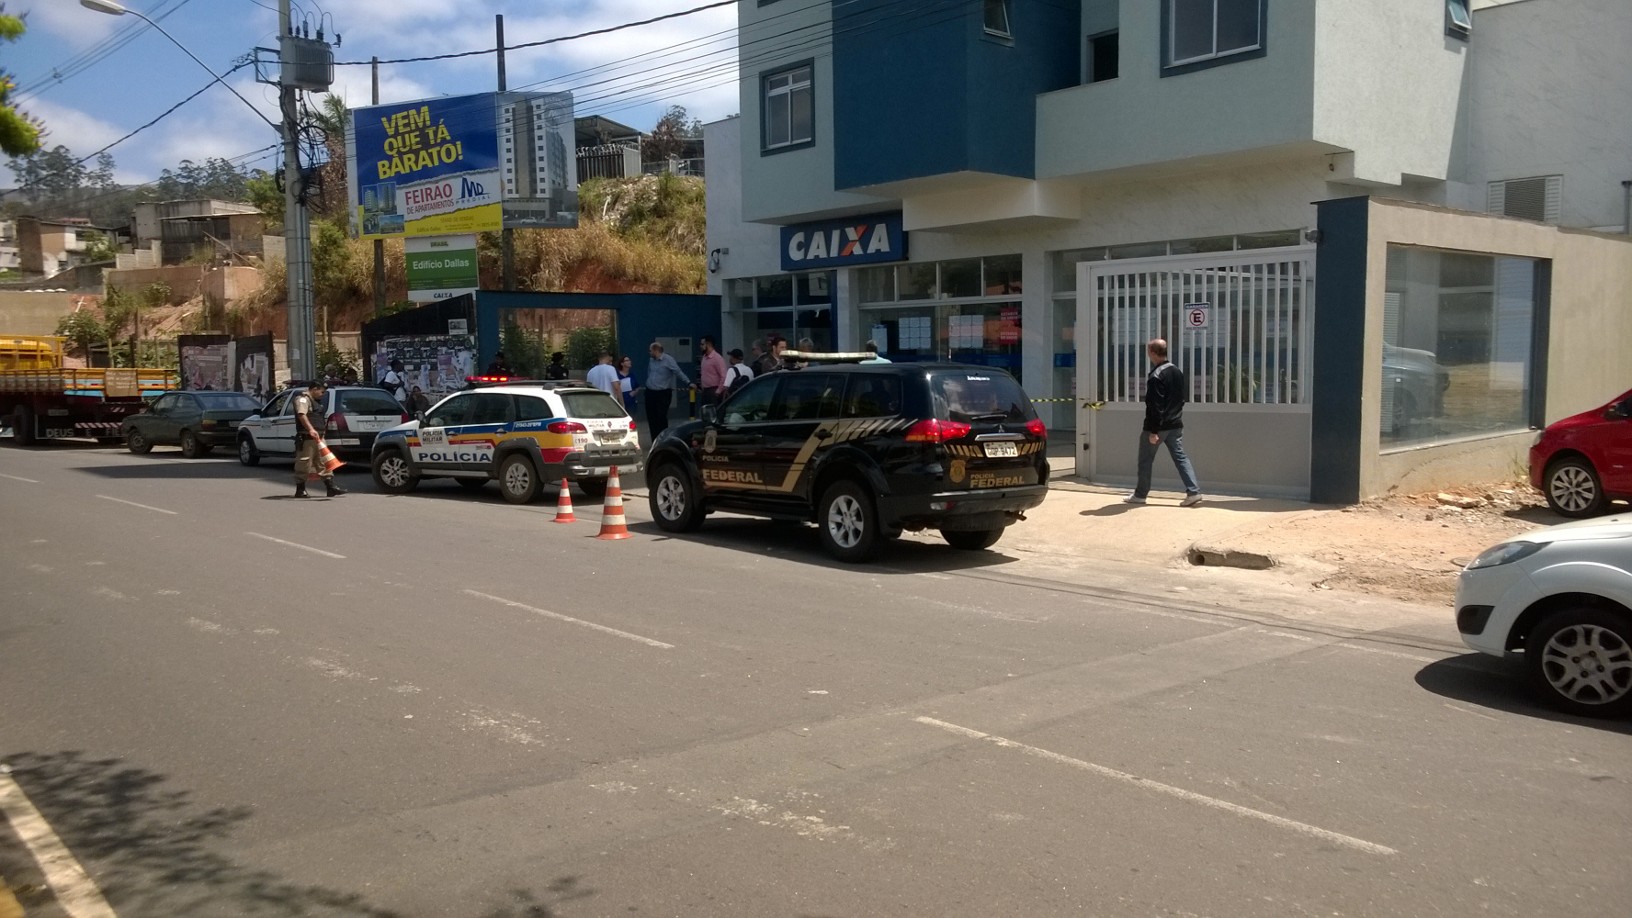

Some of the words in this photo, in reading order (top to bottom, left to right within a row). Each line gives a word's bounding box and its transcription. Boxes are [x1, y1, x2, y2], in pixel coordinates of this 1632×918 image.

[381, 105, 430, 136] VEM
[384, 130, 423, 157] QUE
[425, 118, 451, 145] TÁ
[377, 141, 463, 180] BARATO!
[407, 207, 414, 215] DE
[415, 199, 455, 213] APARTAMENTOS
[788, 223, 891, 261] CAIXA
[444, 259, 470, 268] Dallas
[46, 428, 74, 437] DEUS
[418, 451, 491, 462] POLÍCIA
[702, 469, 763, 483] FEDERAL
[970, 476, 1024, 488] FEDERAL
